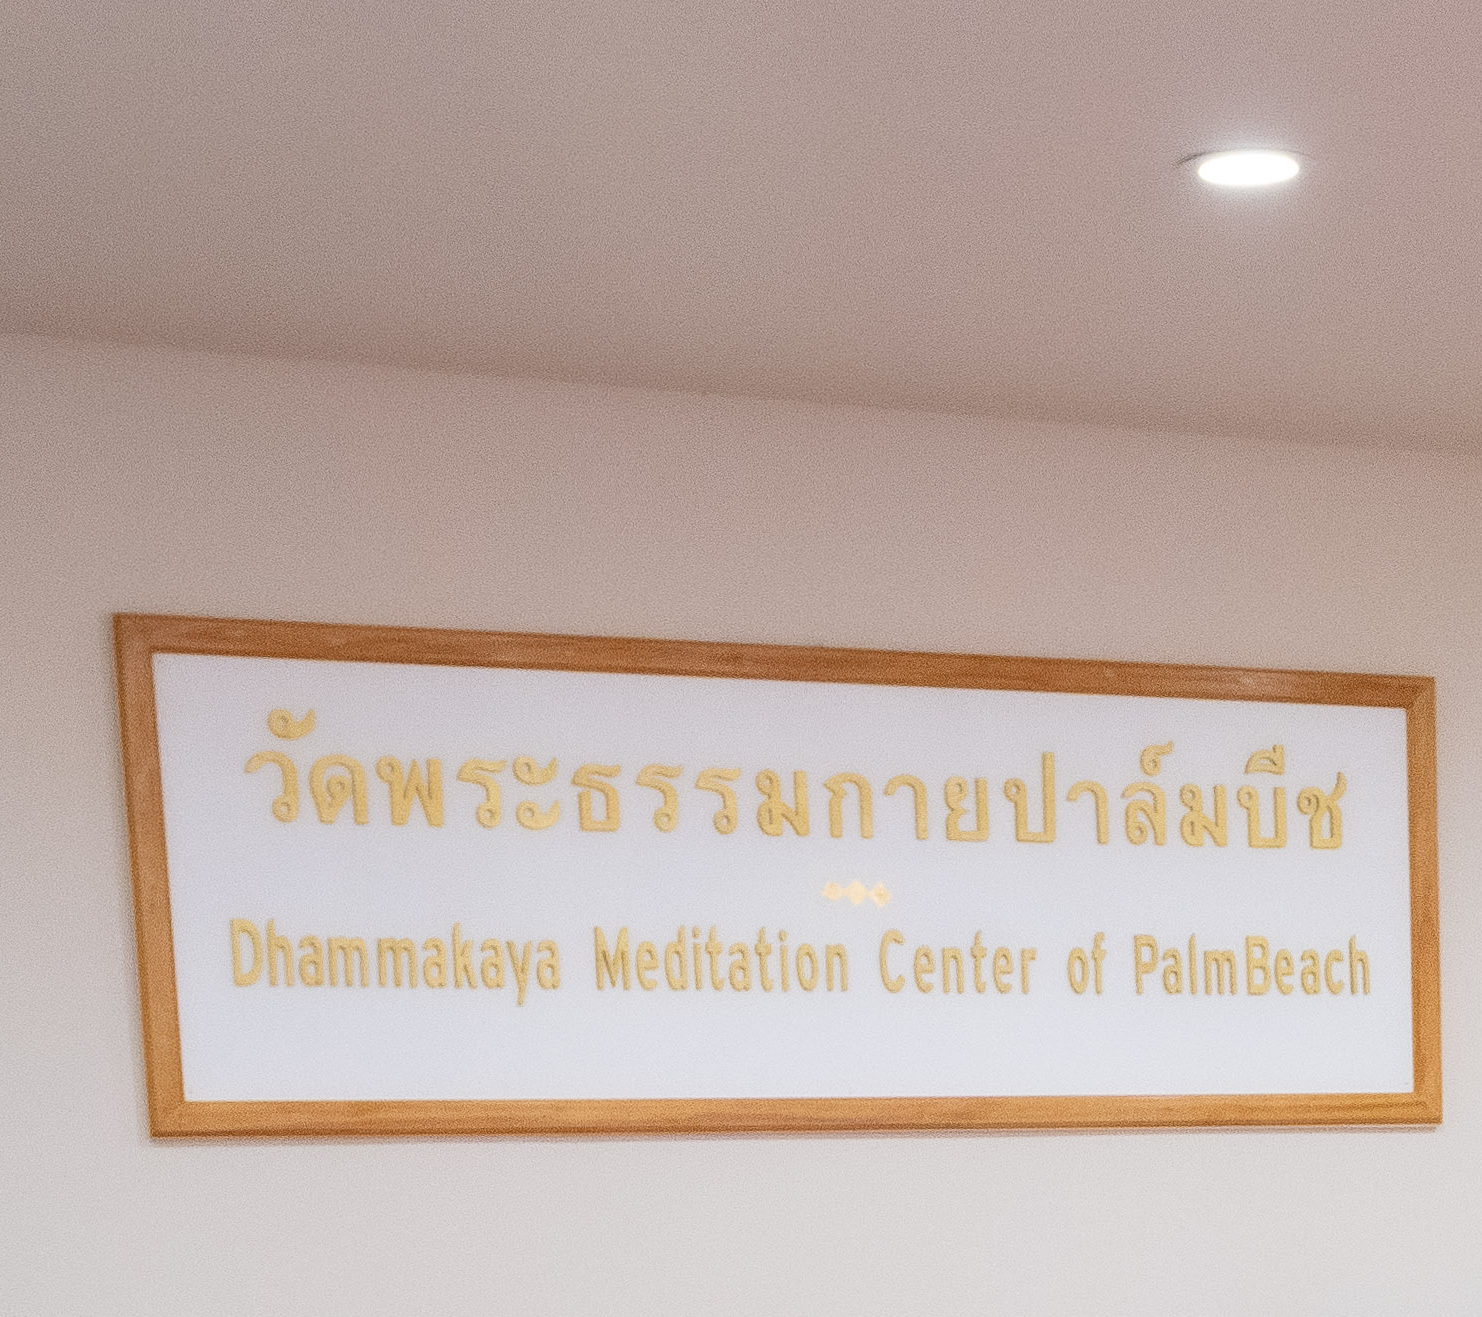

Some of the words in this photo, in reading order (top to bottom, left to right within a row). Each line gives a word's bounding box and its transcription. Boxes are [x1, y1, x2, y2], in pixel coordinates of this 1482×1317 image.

[242, 705, 1349, 854] วัดพระธรรมกายปาล์มบีช
[227, 915, 563, 1008] Dhammakaya
[591, 922, 851, 997] Meditation
[876, 926, 1039, 998] Center
[1065, 929, 1108, 998] of
[1130, 931, 1374, 1000] PalmBeach
